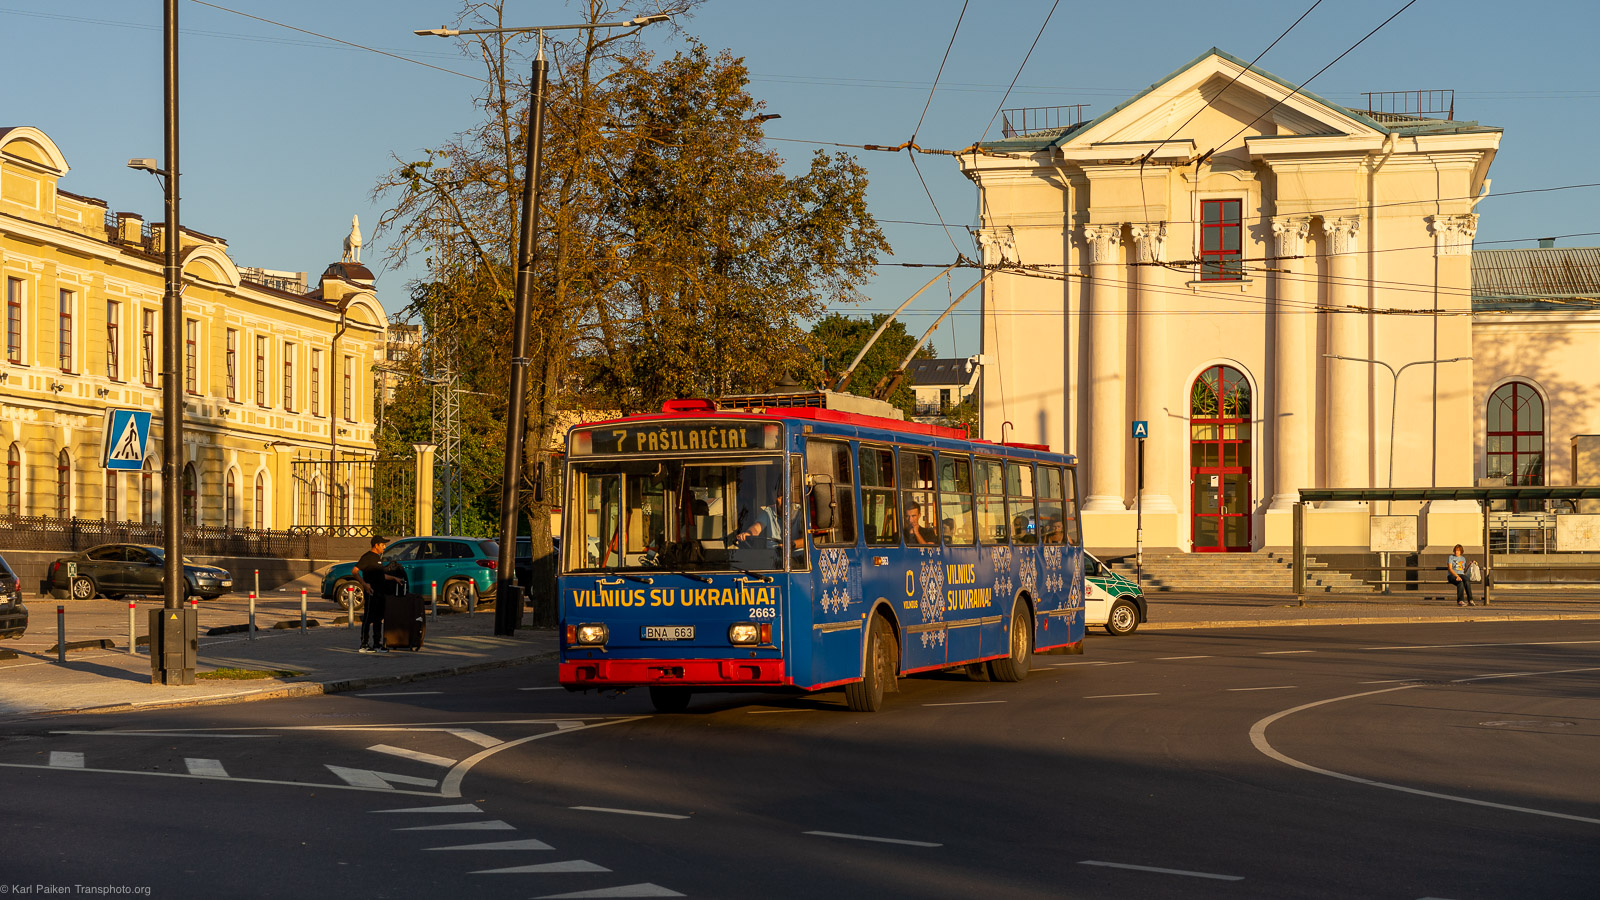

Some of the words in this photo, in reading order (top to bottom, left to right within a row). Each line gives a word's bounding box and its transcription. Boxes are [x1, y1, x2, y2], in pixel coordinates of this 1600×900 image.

[1135, 423, 1146, 435] A
[613, 430, 627, 452] 7
[637, 427, 747, 451] PAŠILAIČIAI
[946, 563, 976, 585] VILNIUS
[573, 589, 645, 607] VILNIUS
[650, 588, 675, 606] SU
[680, 587, 776, 606] UKRAINA!
[903, 600, 919, 609] VILNIUS
[947, 590, 958, 611] SU
[959, 588, 992, 610] UKRAINA!
[749, 607, 776, 618] 2663
[647, 628, 668, 638] BNA
[674, 628, 692, 638] 663
